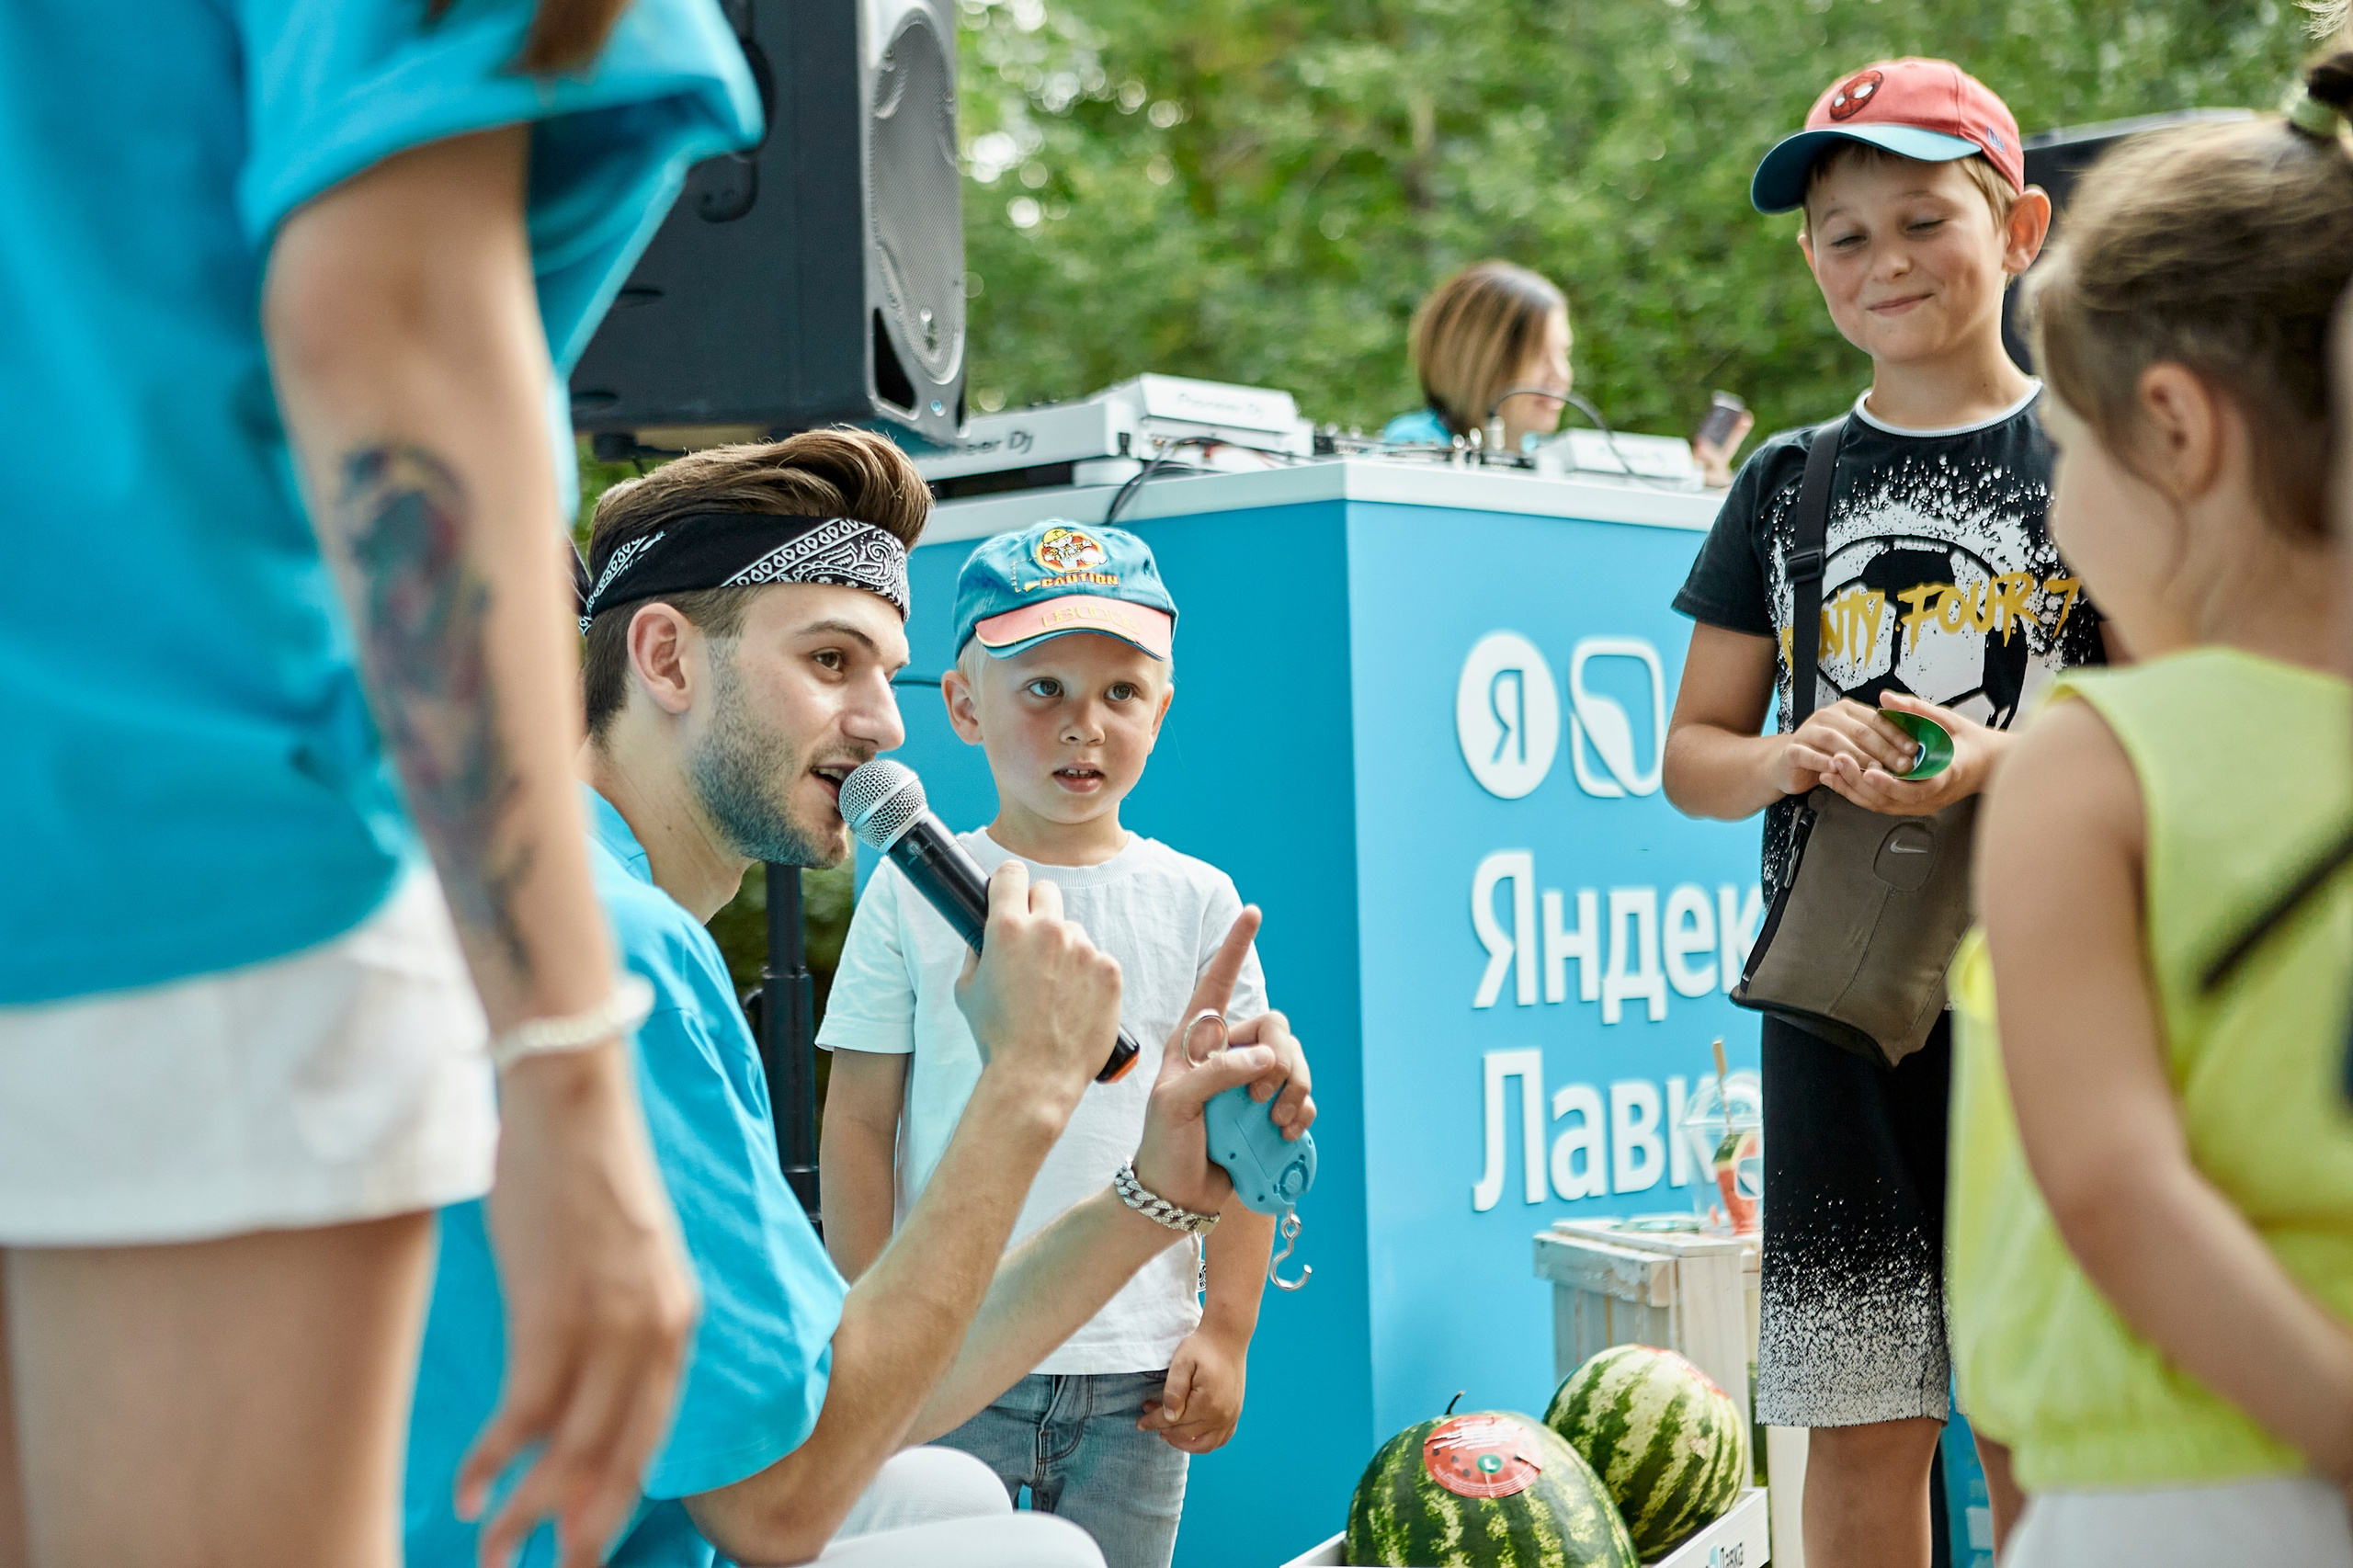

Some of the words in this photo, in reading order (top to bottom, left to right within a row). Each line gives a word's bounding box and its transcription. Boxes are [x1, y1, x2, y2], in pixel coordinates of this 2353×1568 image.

[1040, 572, 1120, 587] CAUTION
[1897, 571, 2041, 656] FOUR
[1471, 847, 1762, 1024] Яндек
